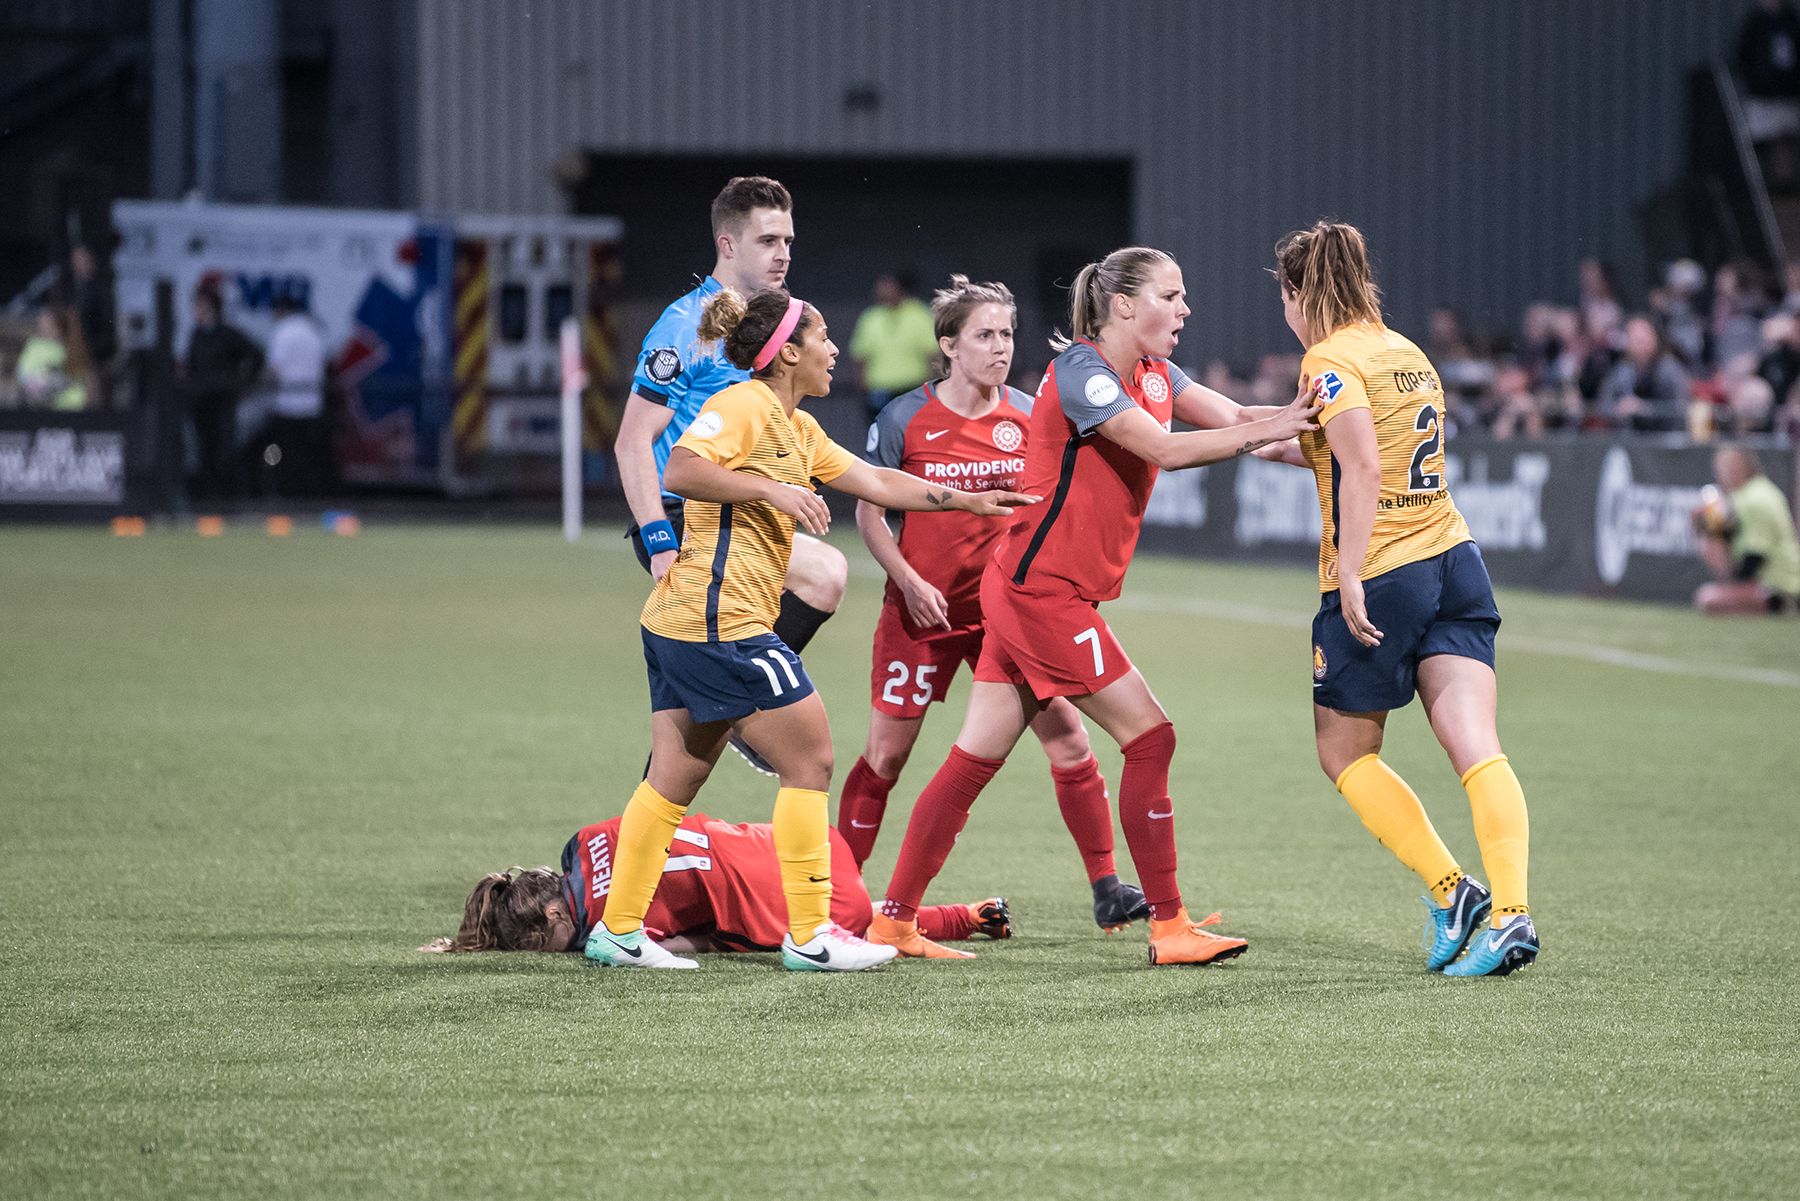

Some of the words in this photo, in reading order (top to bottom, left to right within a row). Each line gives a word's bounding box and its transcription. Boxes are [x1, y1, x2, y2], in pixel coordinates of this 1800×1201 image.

[659, 353, 676, 365] USA
[1408, 403, 1440, 492] 2
[963, 479, 973, 490] &
[976, 477, 1017, 489] Services
[1396, 494, 1434, 510] Utility
[648, 530, 671, 545] H.D.
[750, 649, 801, 697] 11
[1072, 626, 1105, 678] 7
[882, 660, 938, 706] 25
[587, 832, 612, 899] HEATH
